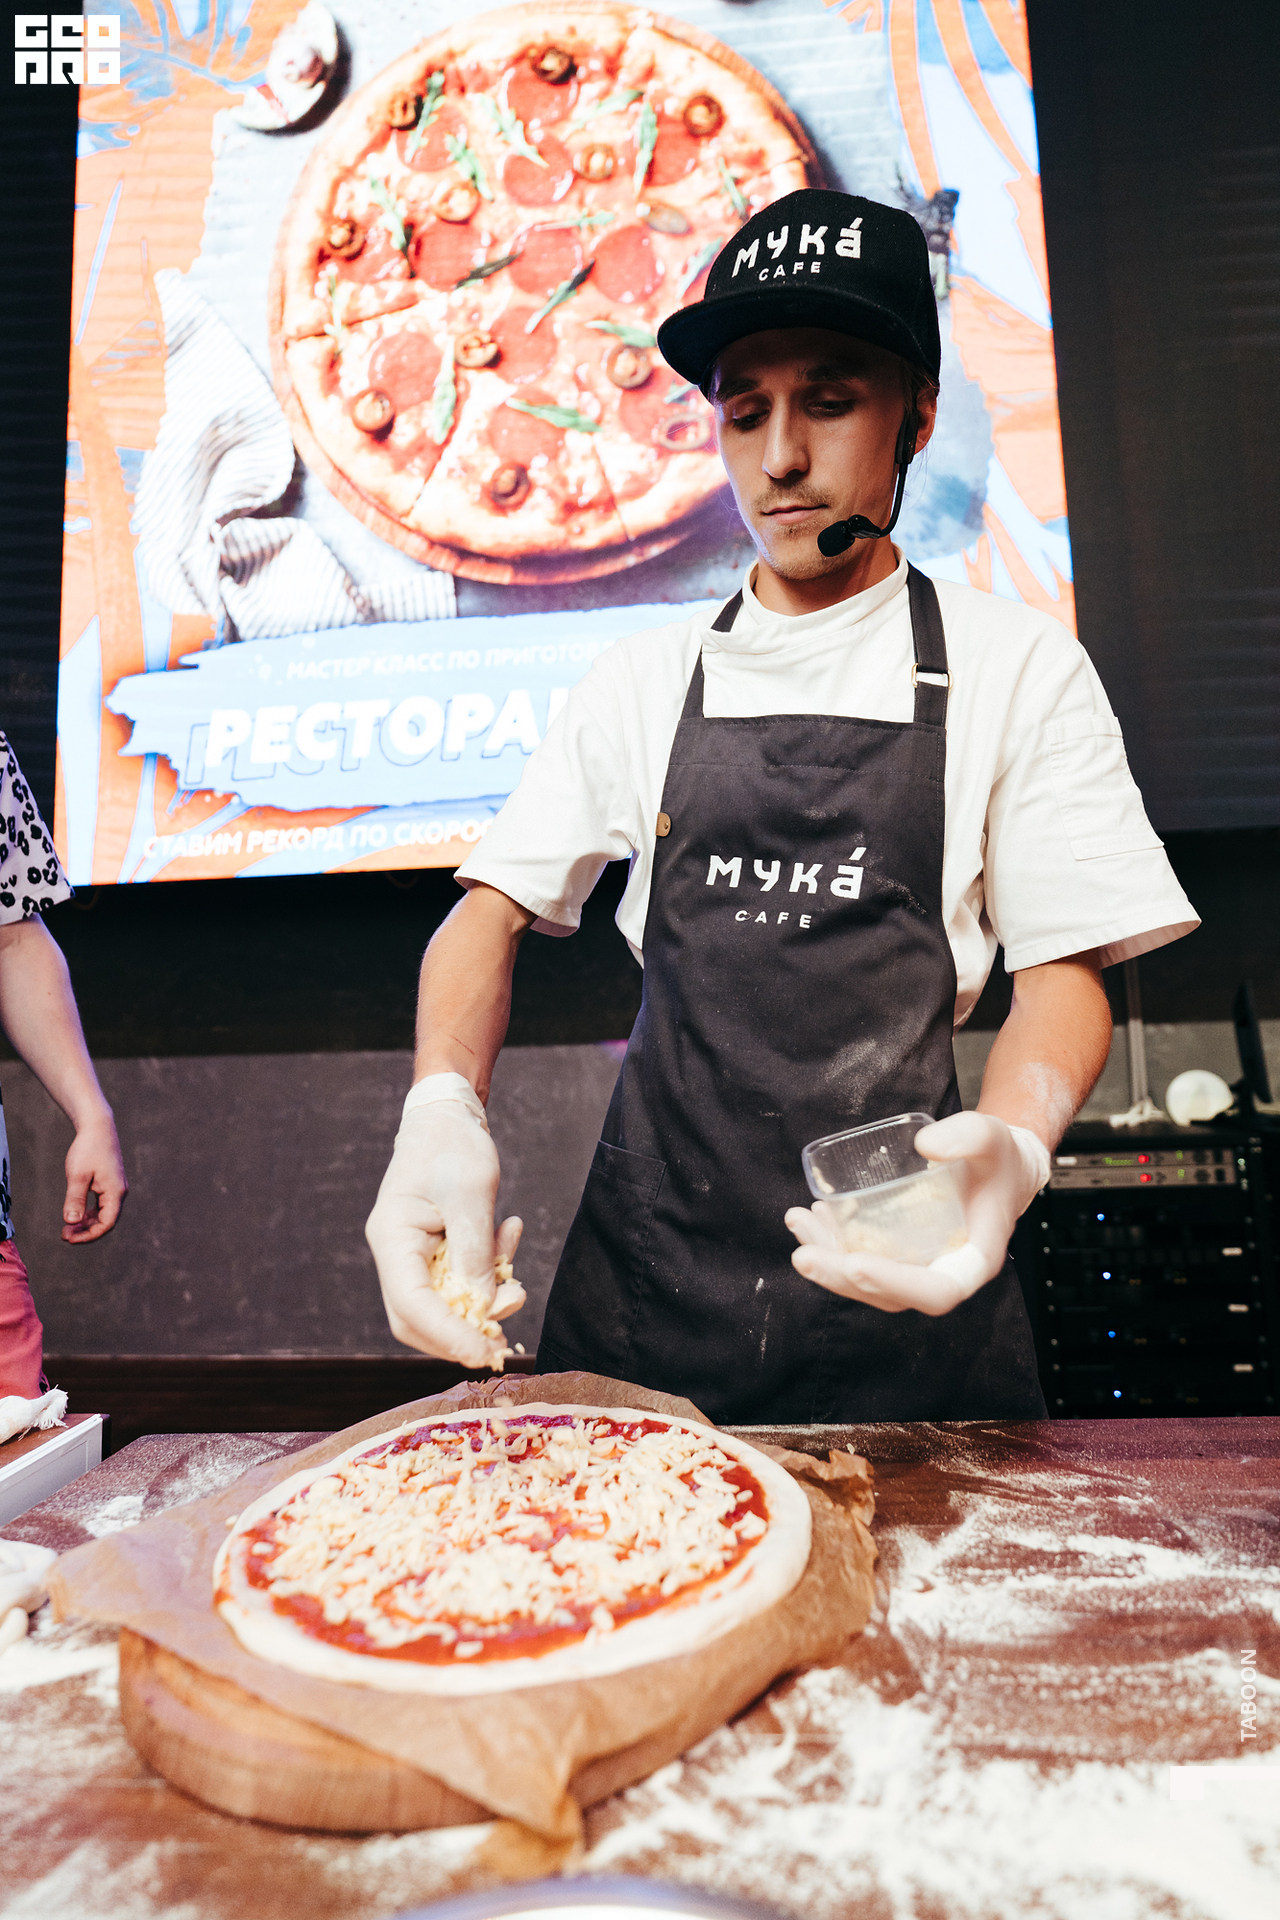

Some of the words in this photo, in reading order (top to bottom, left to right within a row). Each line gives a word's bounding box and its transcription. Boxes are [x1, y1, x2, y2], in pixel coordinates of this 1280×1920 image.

[758, 261, 821, 282] CAFE
[286, 656, 371, 681] МАСТЕР
[372, 651, 444, 675] КЛАСС
[447, 650, 481, 670] ПО
[143, 830, 243, 858] СТАВИМ
[246, 826, 344, 854] РЕКОРД
[350, 824, 388, 848] ПО
[734, 910, 812, 929] CAFE
